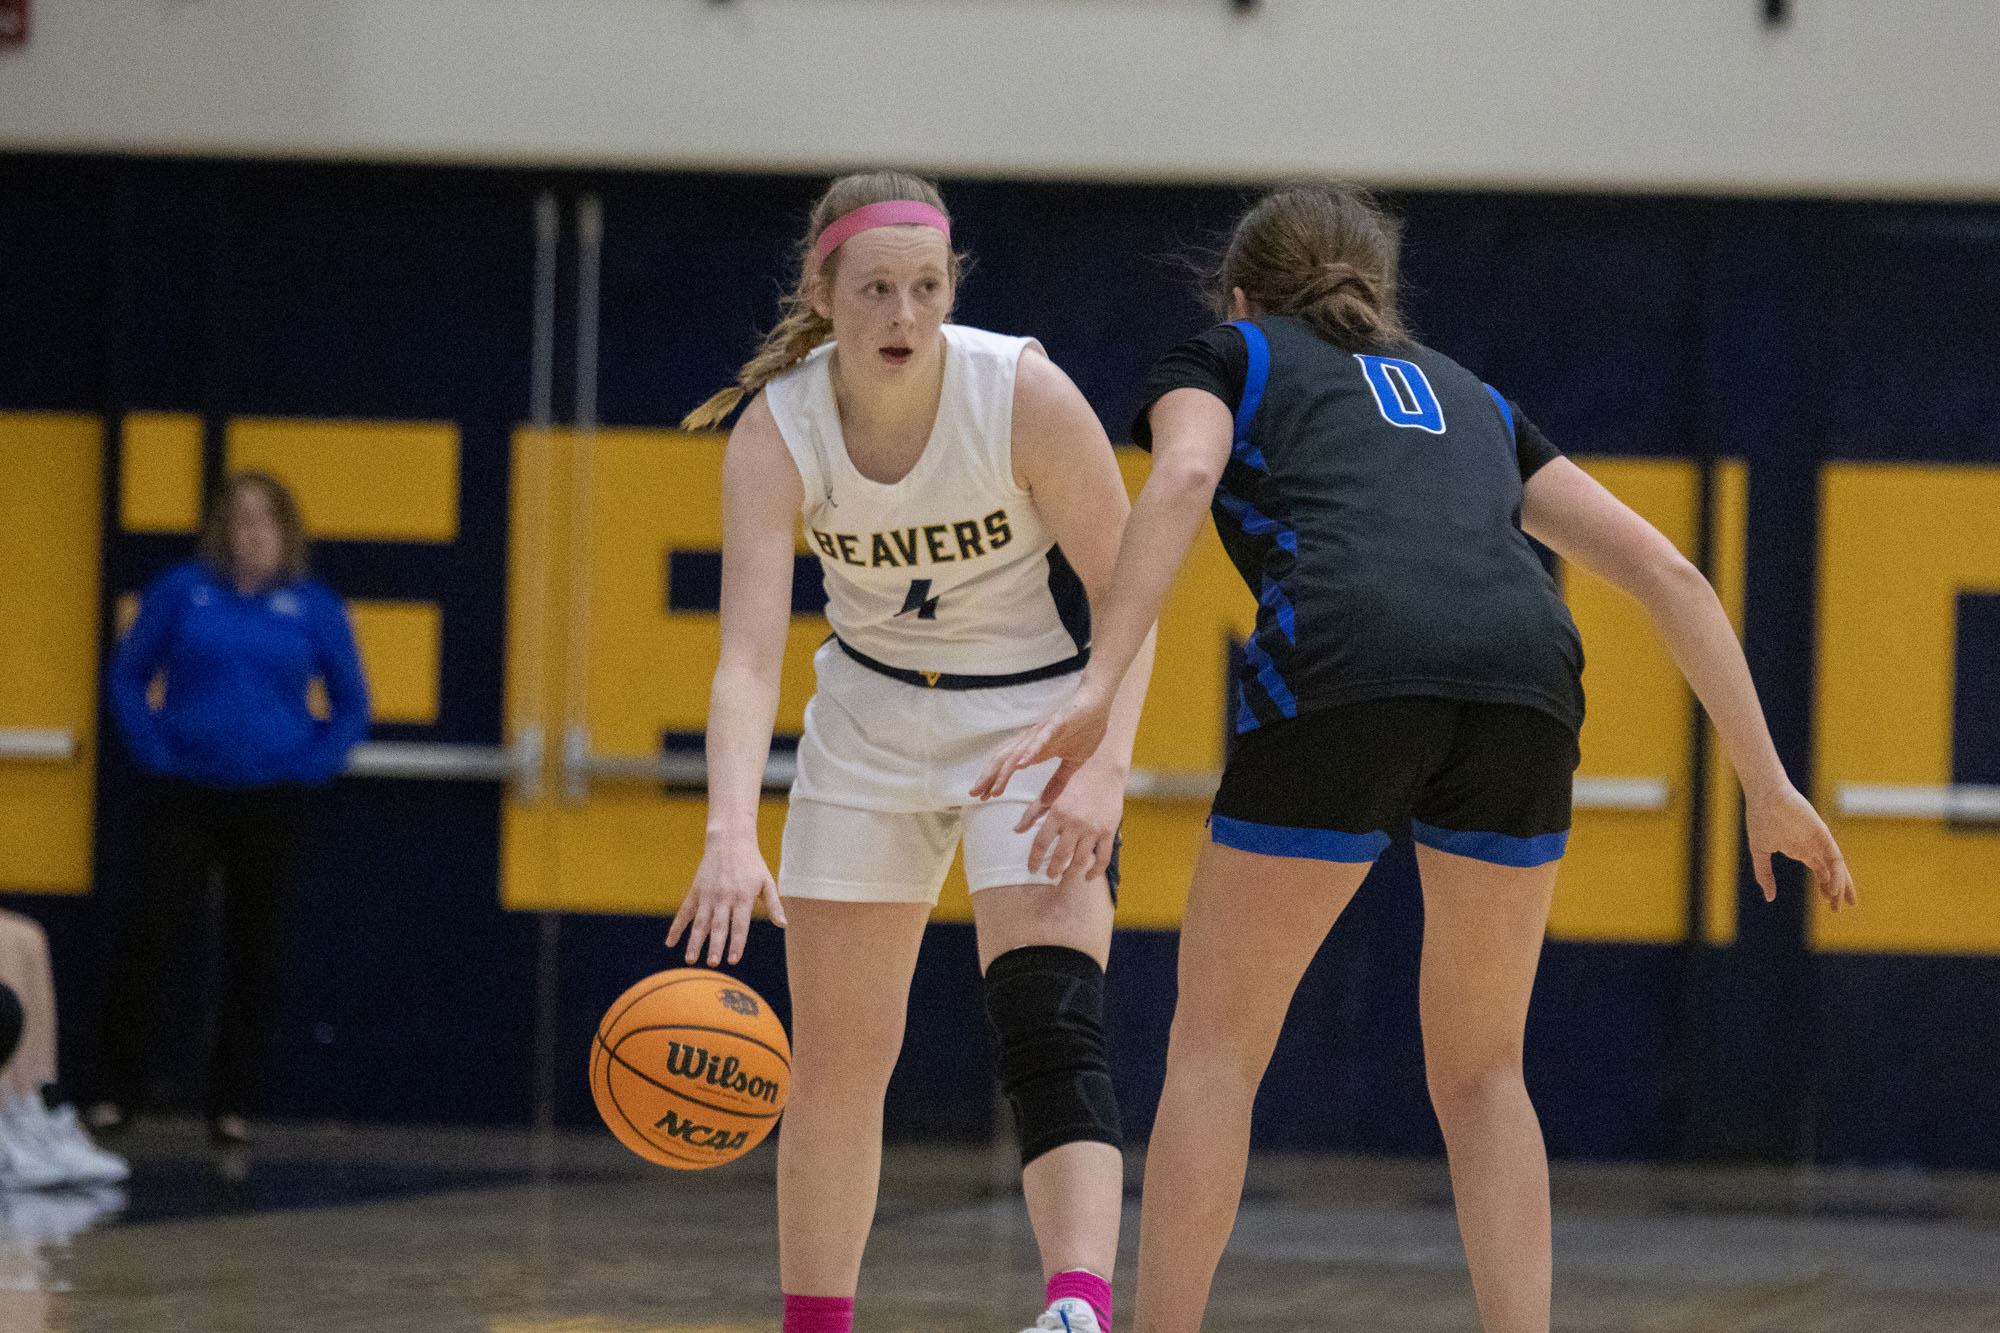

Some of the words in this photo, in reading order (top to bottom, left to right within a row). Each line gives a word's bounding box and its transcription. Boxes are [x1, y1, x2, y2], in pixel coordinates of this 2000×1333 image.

[1352, 353, 1447, 434] 0
[811, 509, 1013, 568] BEAVERS
[666, 1040, 779, 1104] Wilson
[654, 1109, 749, 1151] NCAA
